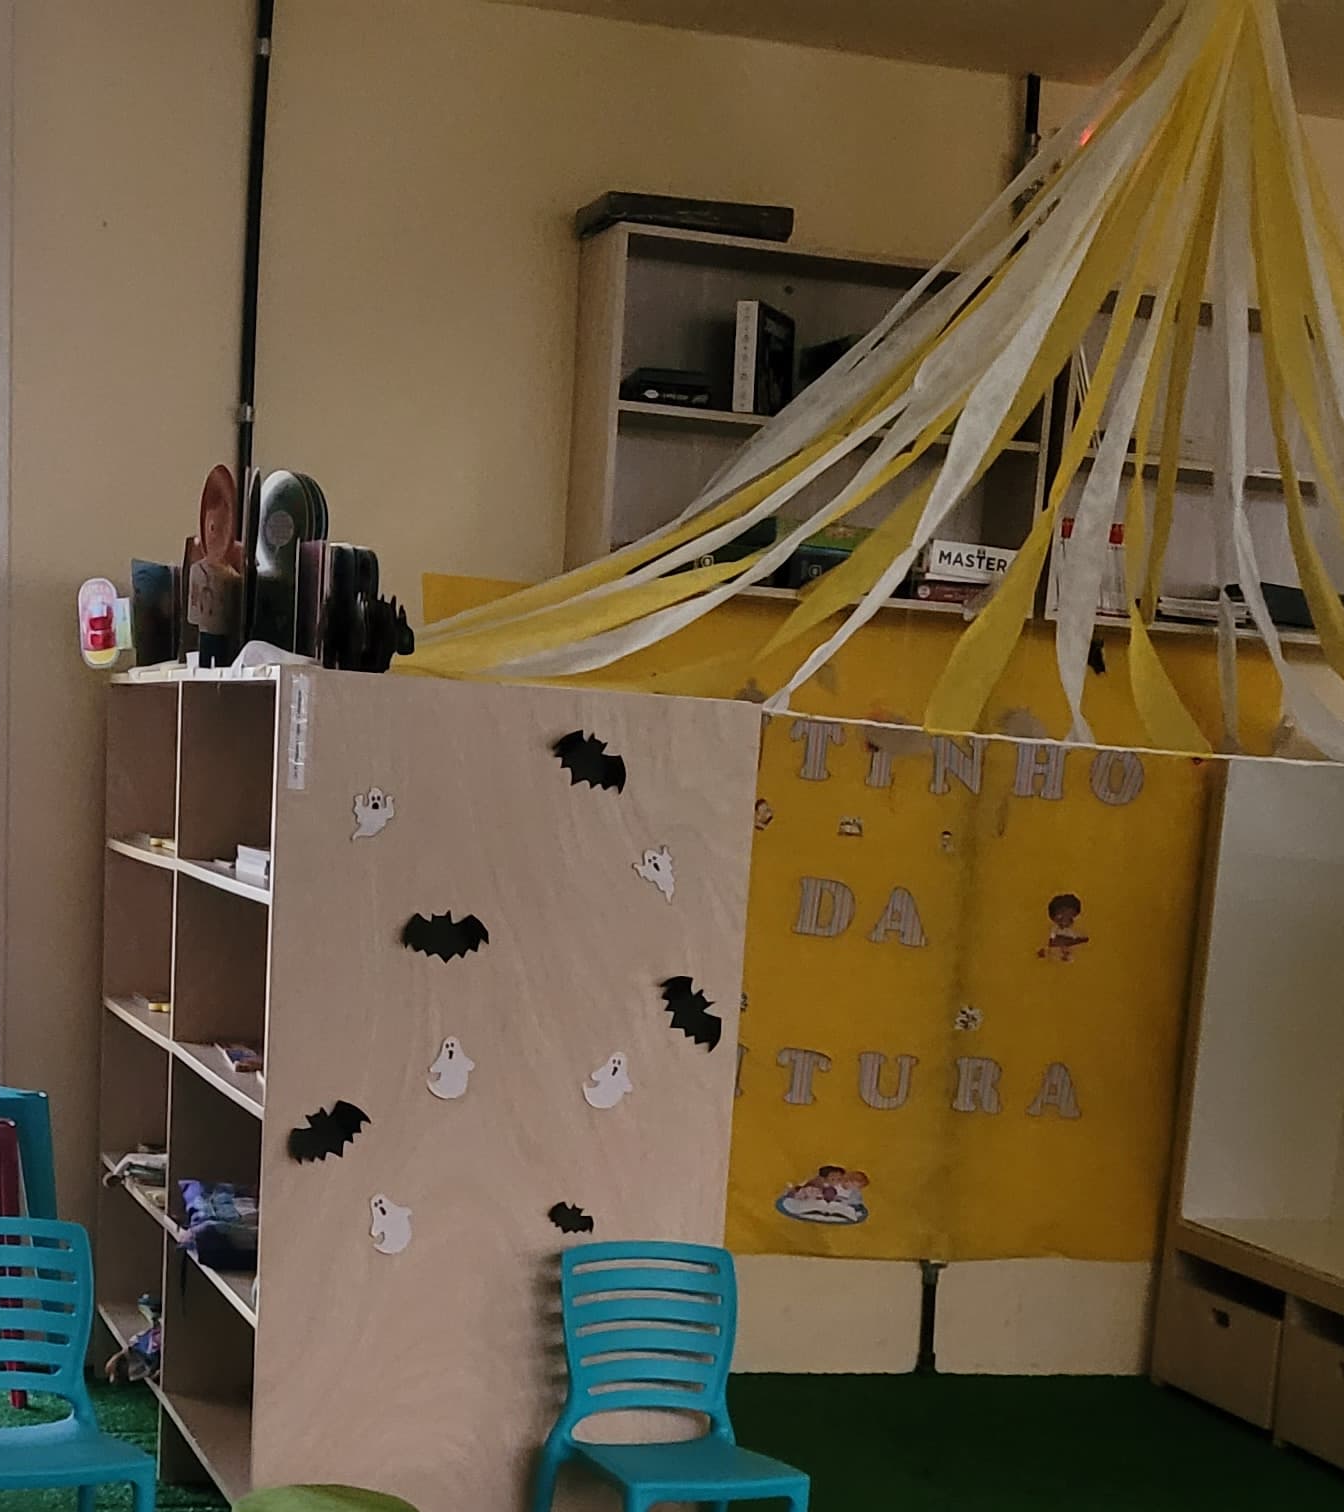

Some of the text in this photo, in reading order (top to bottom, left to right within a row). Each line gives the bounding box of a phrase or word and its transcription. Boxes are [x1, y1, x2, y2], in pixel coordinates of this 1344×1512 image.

[938, 549, 1007, 573] MASTER
[762, 716, 1144, 806] TINHO
[792, 876, 928, 948] DA
